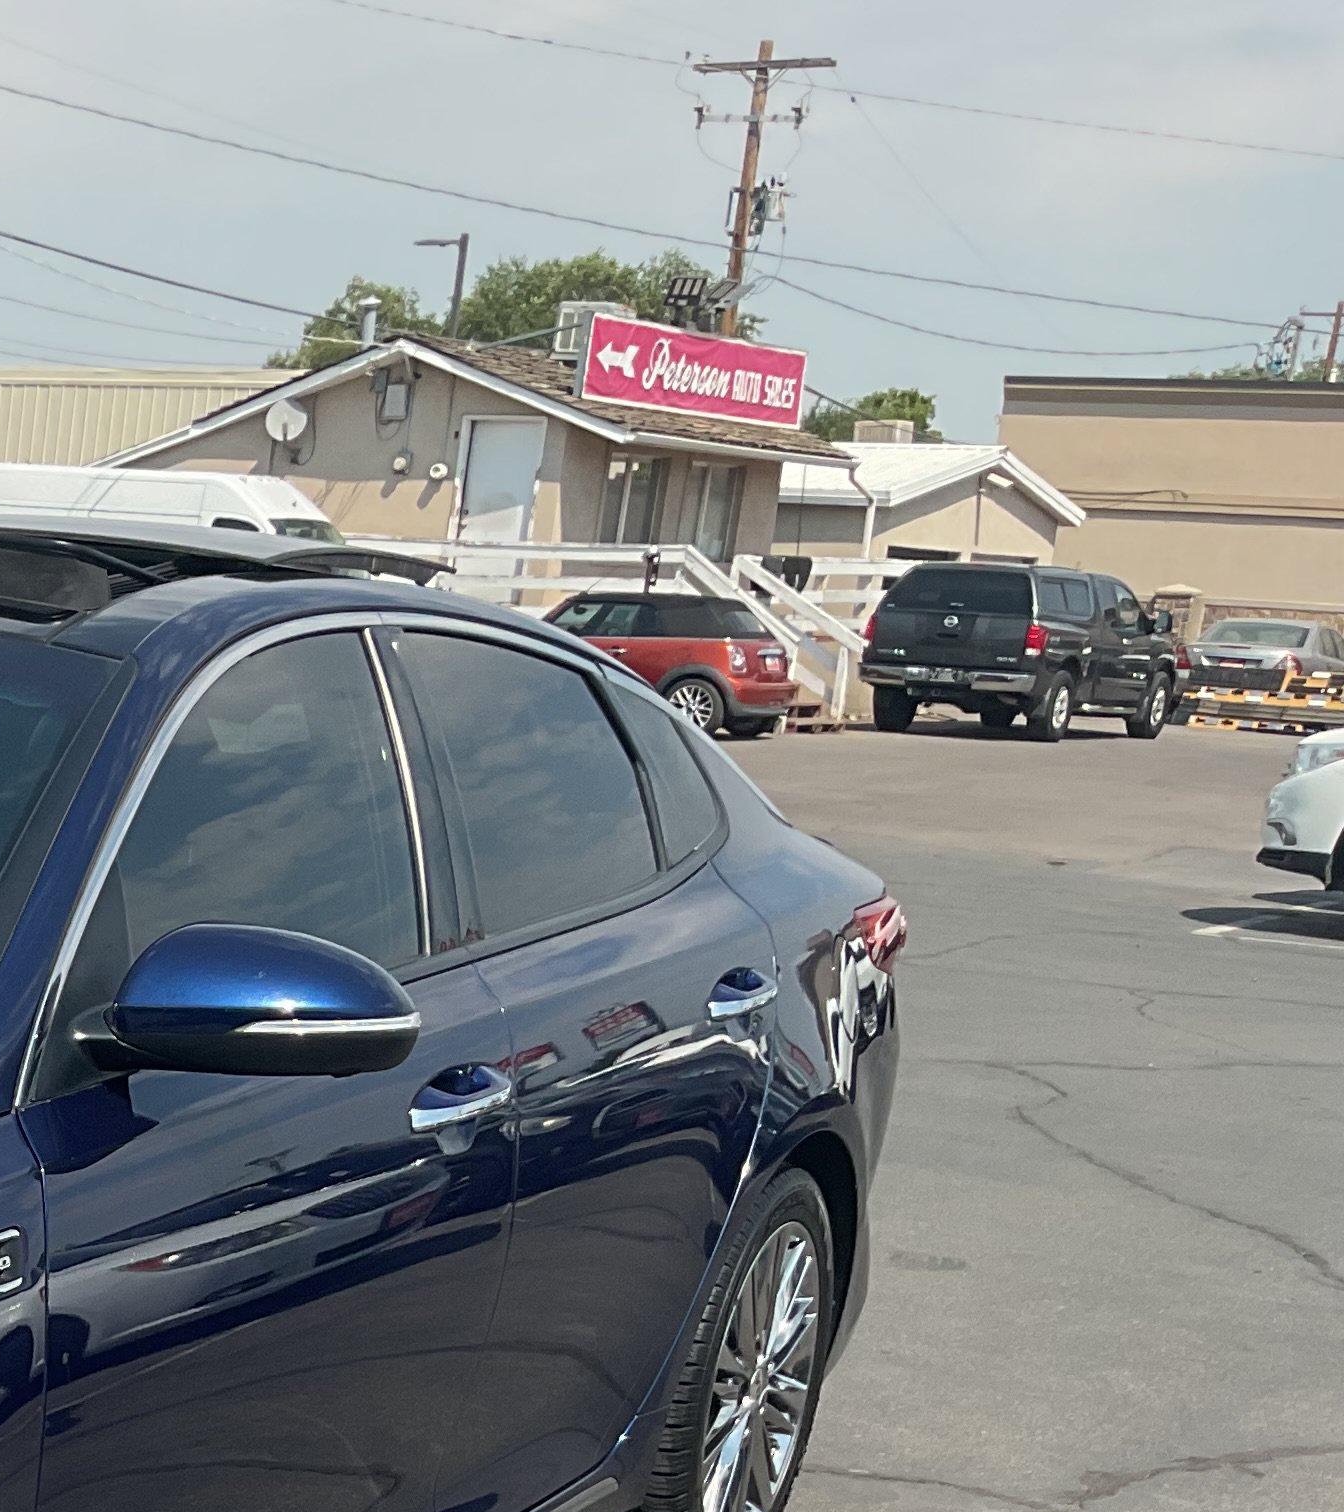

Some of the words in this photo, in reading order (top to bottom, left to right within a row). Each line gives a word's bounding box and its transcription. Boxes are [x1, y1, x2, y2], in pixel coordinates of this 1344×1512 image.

[642, 338, 731, 399] Peterson
[731, 369, 762, 403] AUTO
[762, 374, 797, 409] SALES
